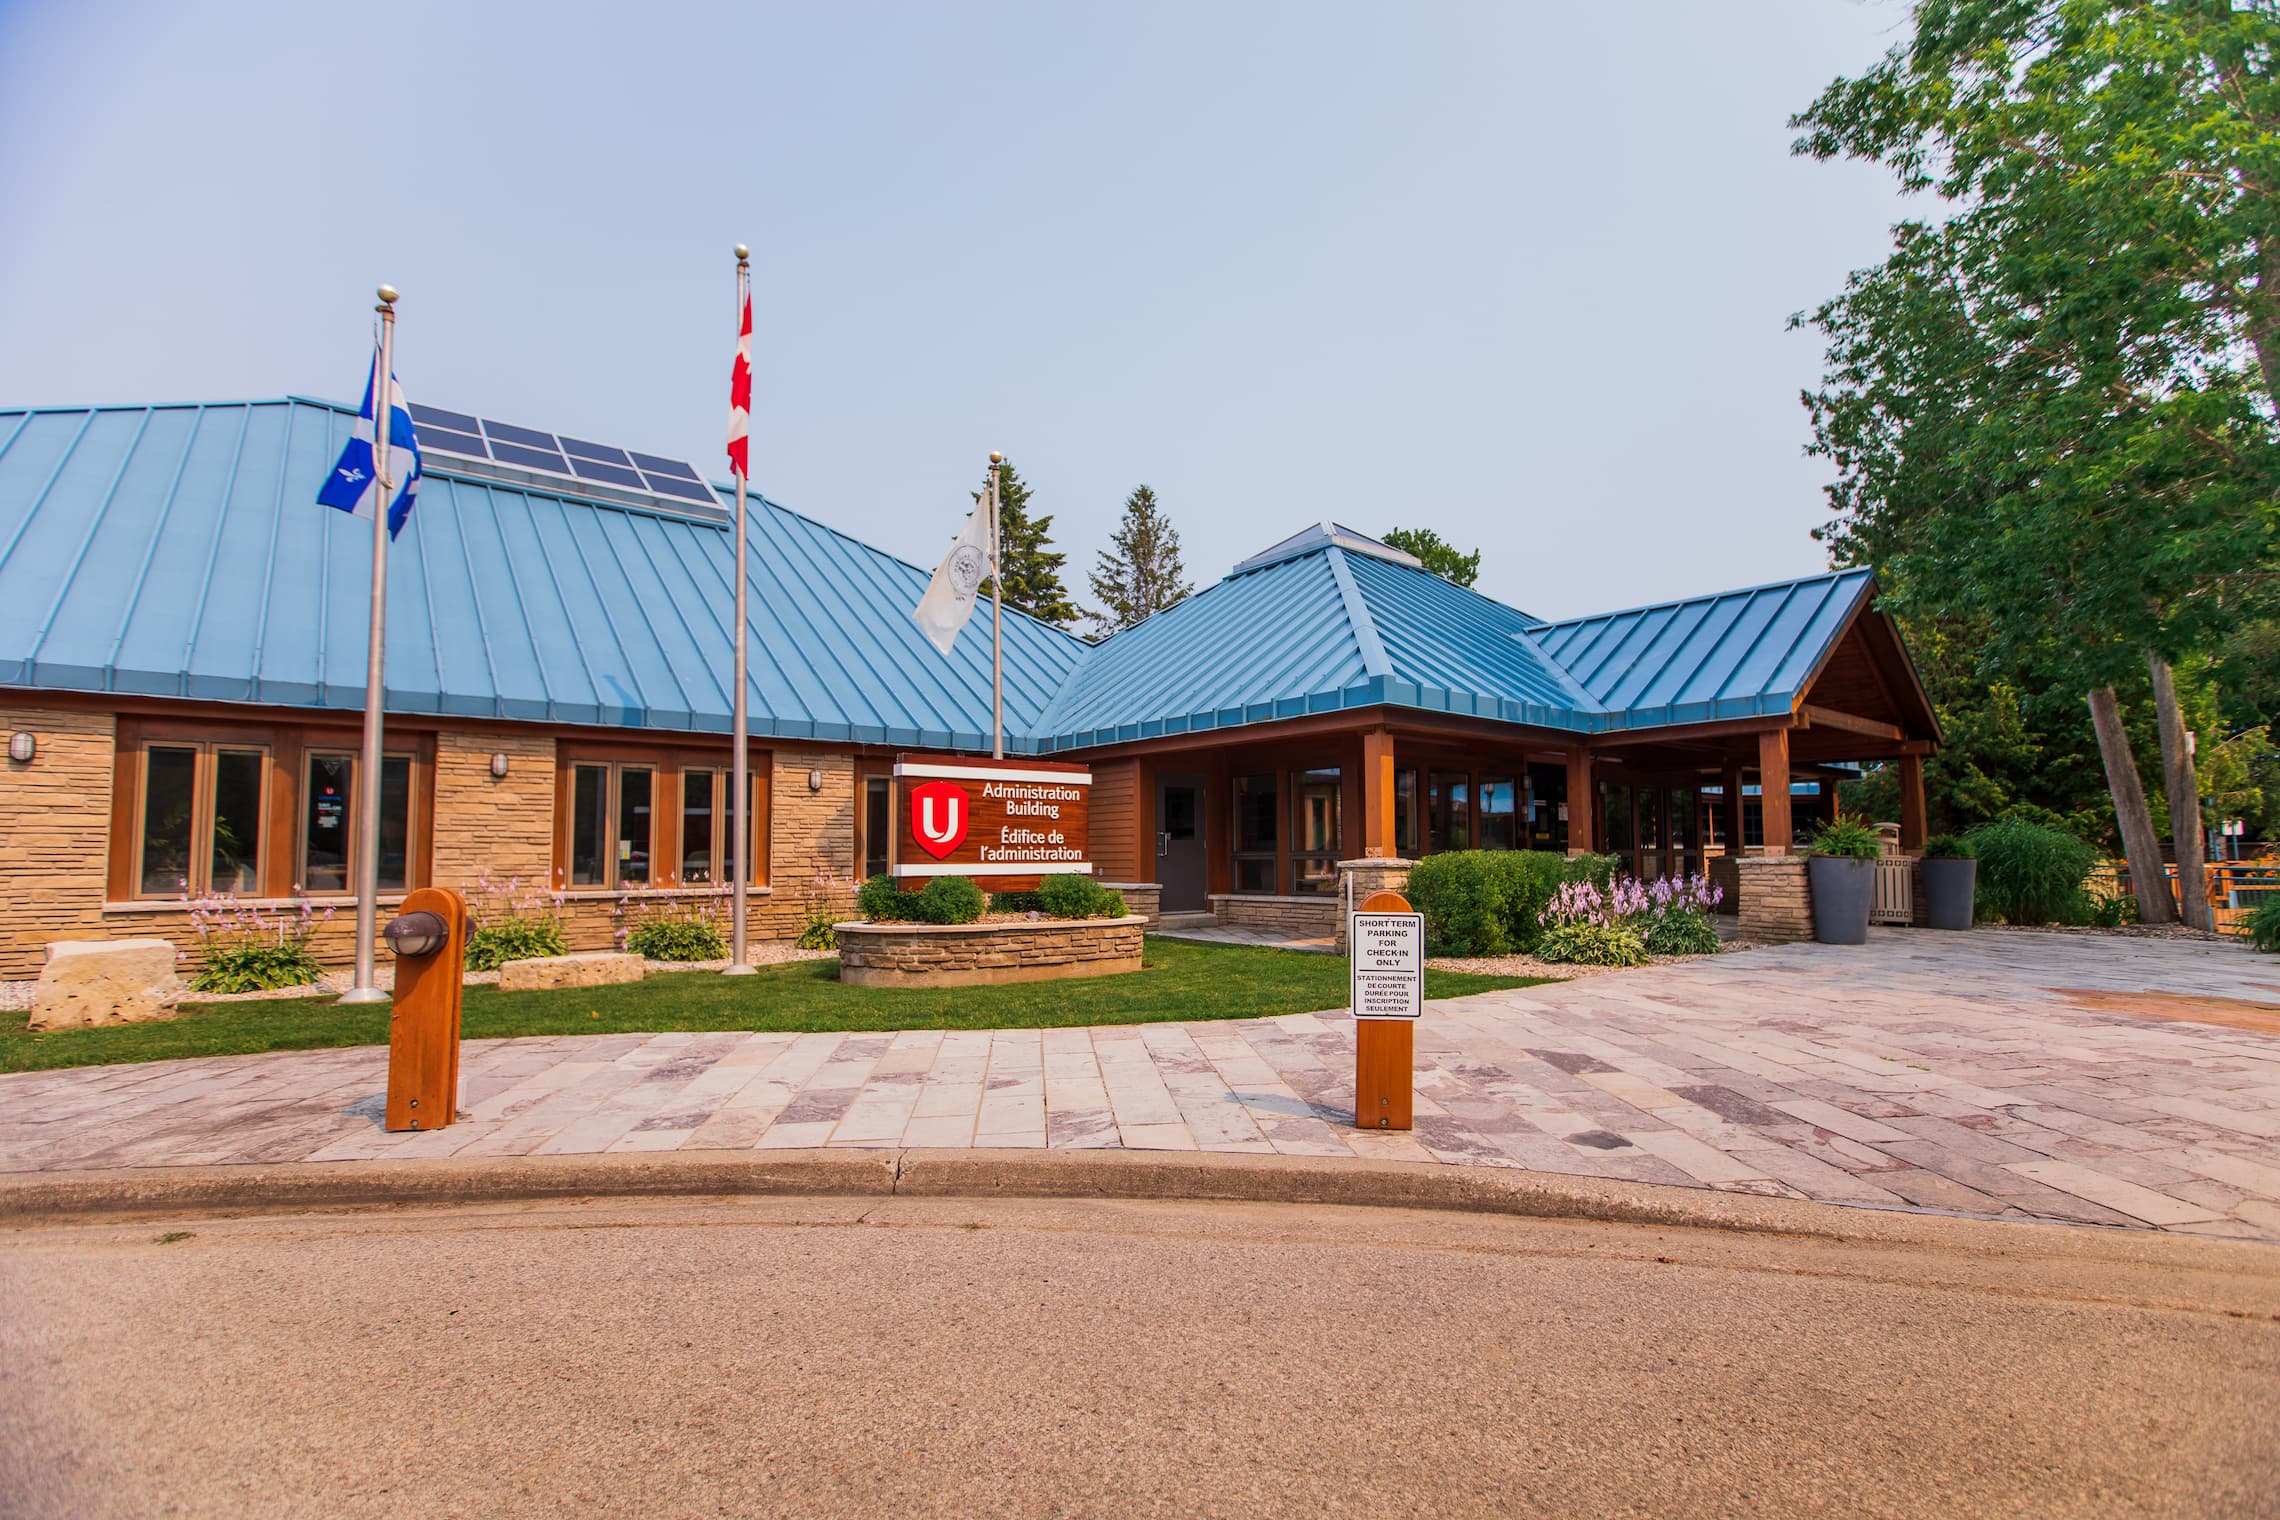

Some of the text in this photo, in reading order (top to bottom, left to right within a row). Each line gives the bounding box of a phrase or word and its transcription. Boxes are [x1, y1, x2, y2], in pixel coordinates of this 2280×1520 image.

[982, 783, 1080, 801] Administration
[1006, 800, 1059, 819] Building
[923, 797, 958, 843] U
[1001, 826, 1064, 844] Édifice de
[980, 846, 1082, 861] l'administration
